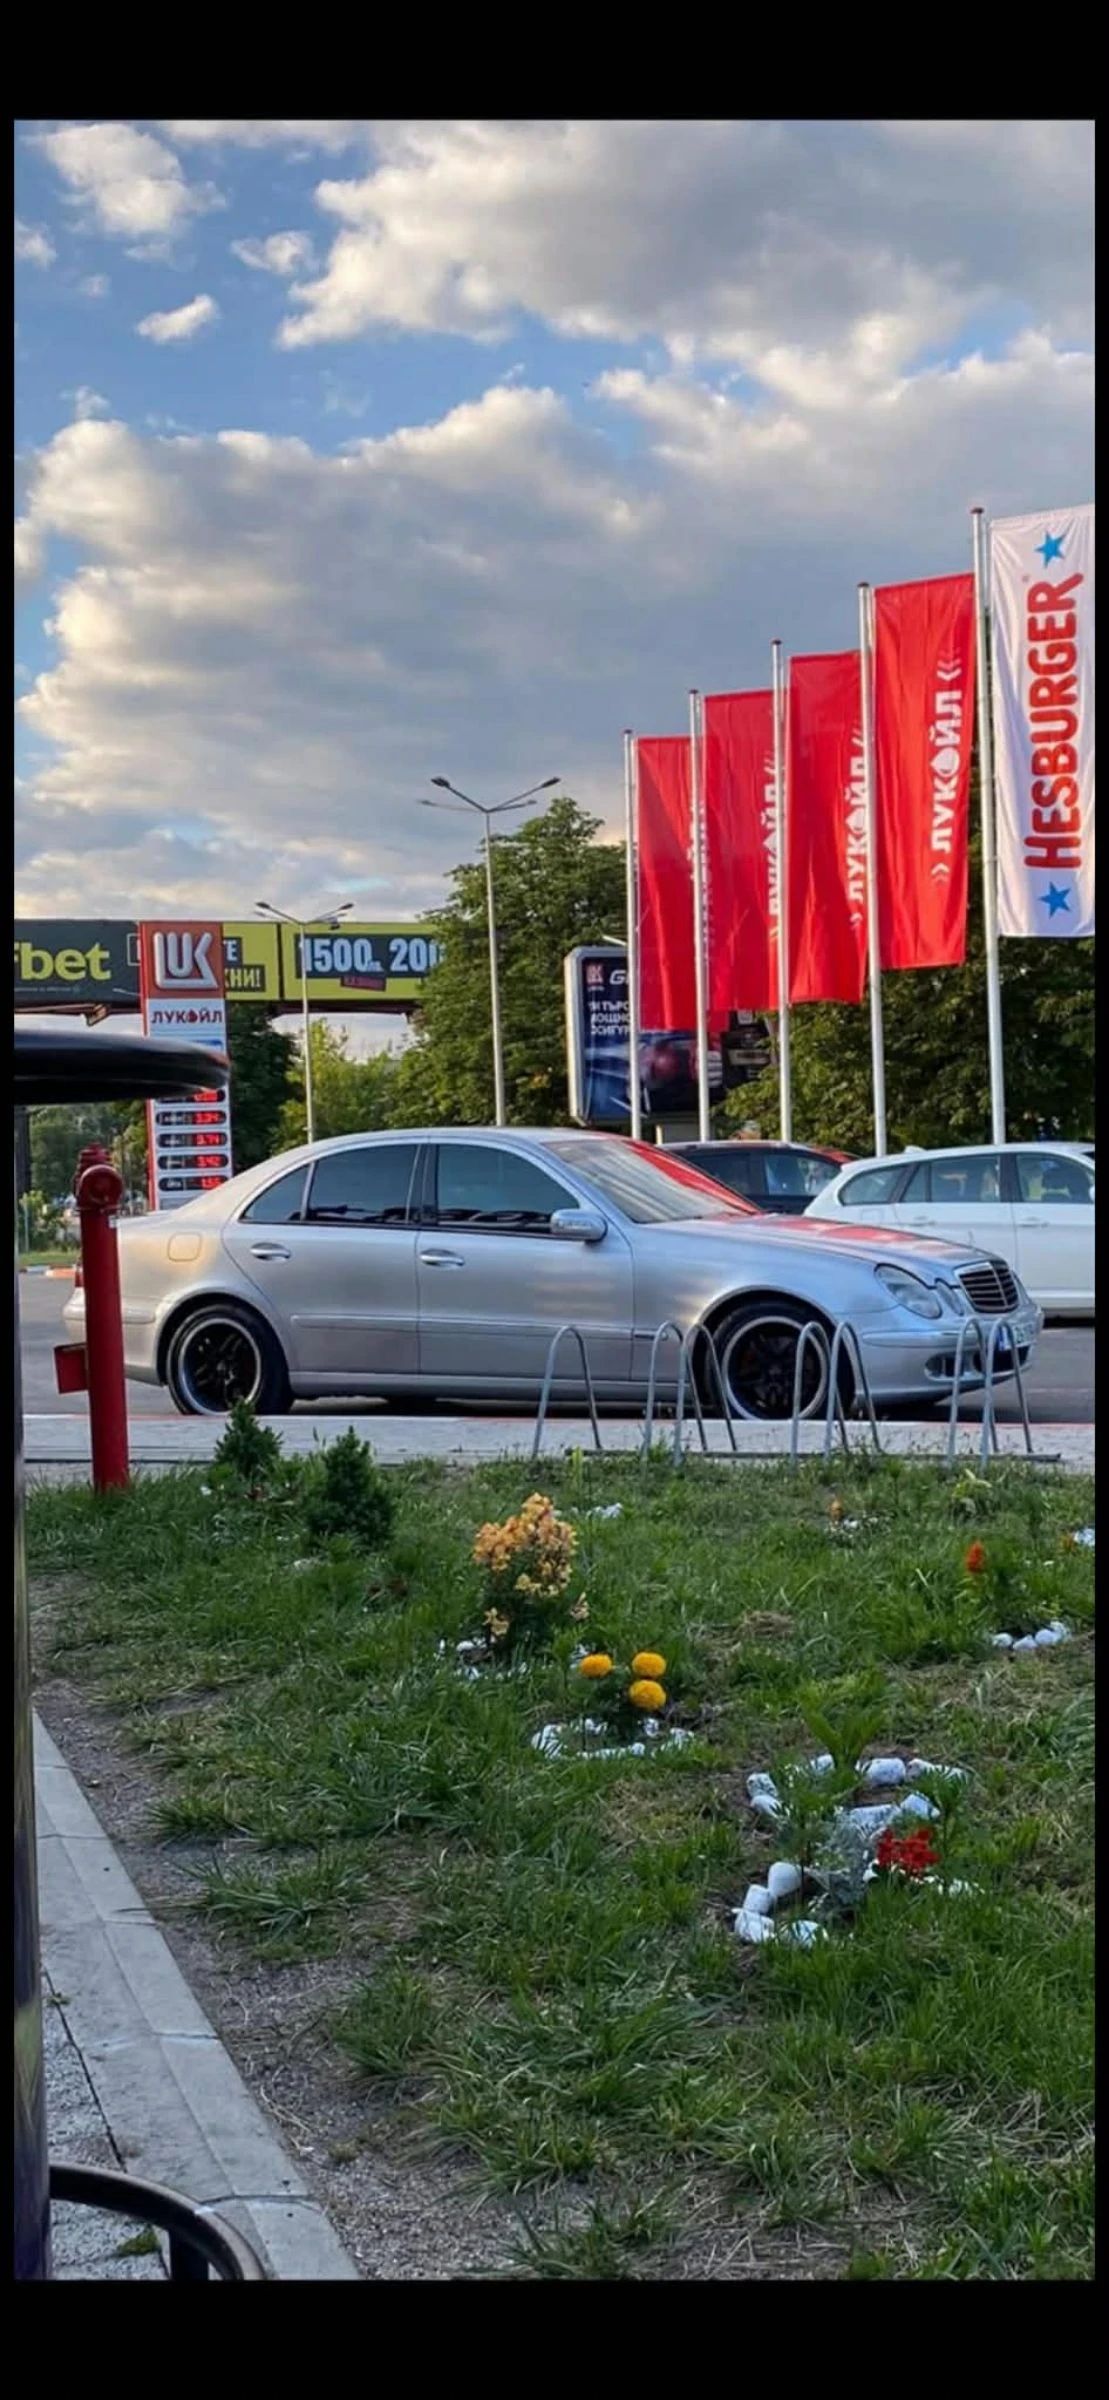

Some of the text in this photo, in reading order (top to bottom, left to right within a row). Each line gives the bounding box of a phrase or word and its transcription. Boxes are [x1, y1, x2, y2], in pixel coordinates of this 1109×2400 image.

[1024, 572, 1084, 869] HESBURGER
[929, 689, 963, 853] ЛУКОЙЛ
[222, 940, 239, 962] Е
[151, 1007, 223, 1024] ЛУКОЙЛ
